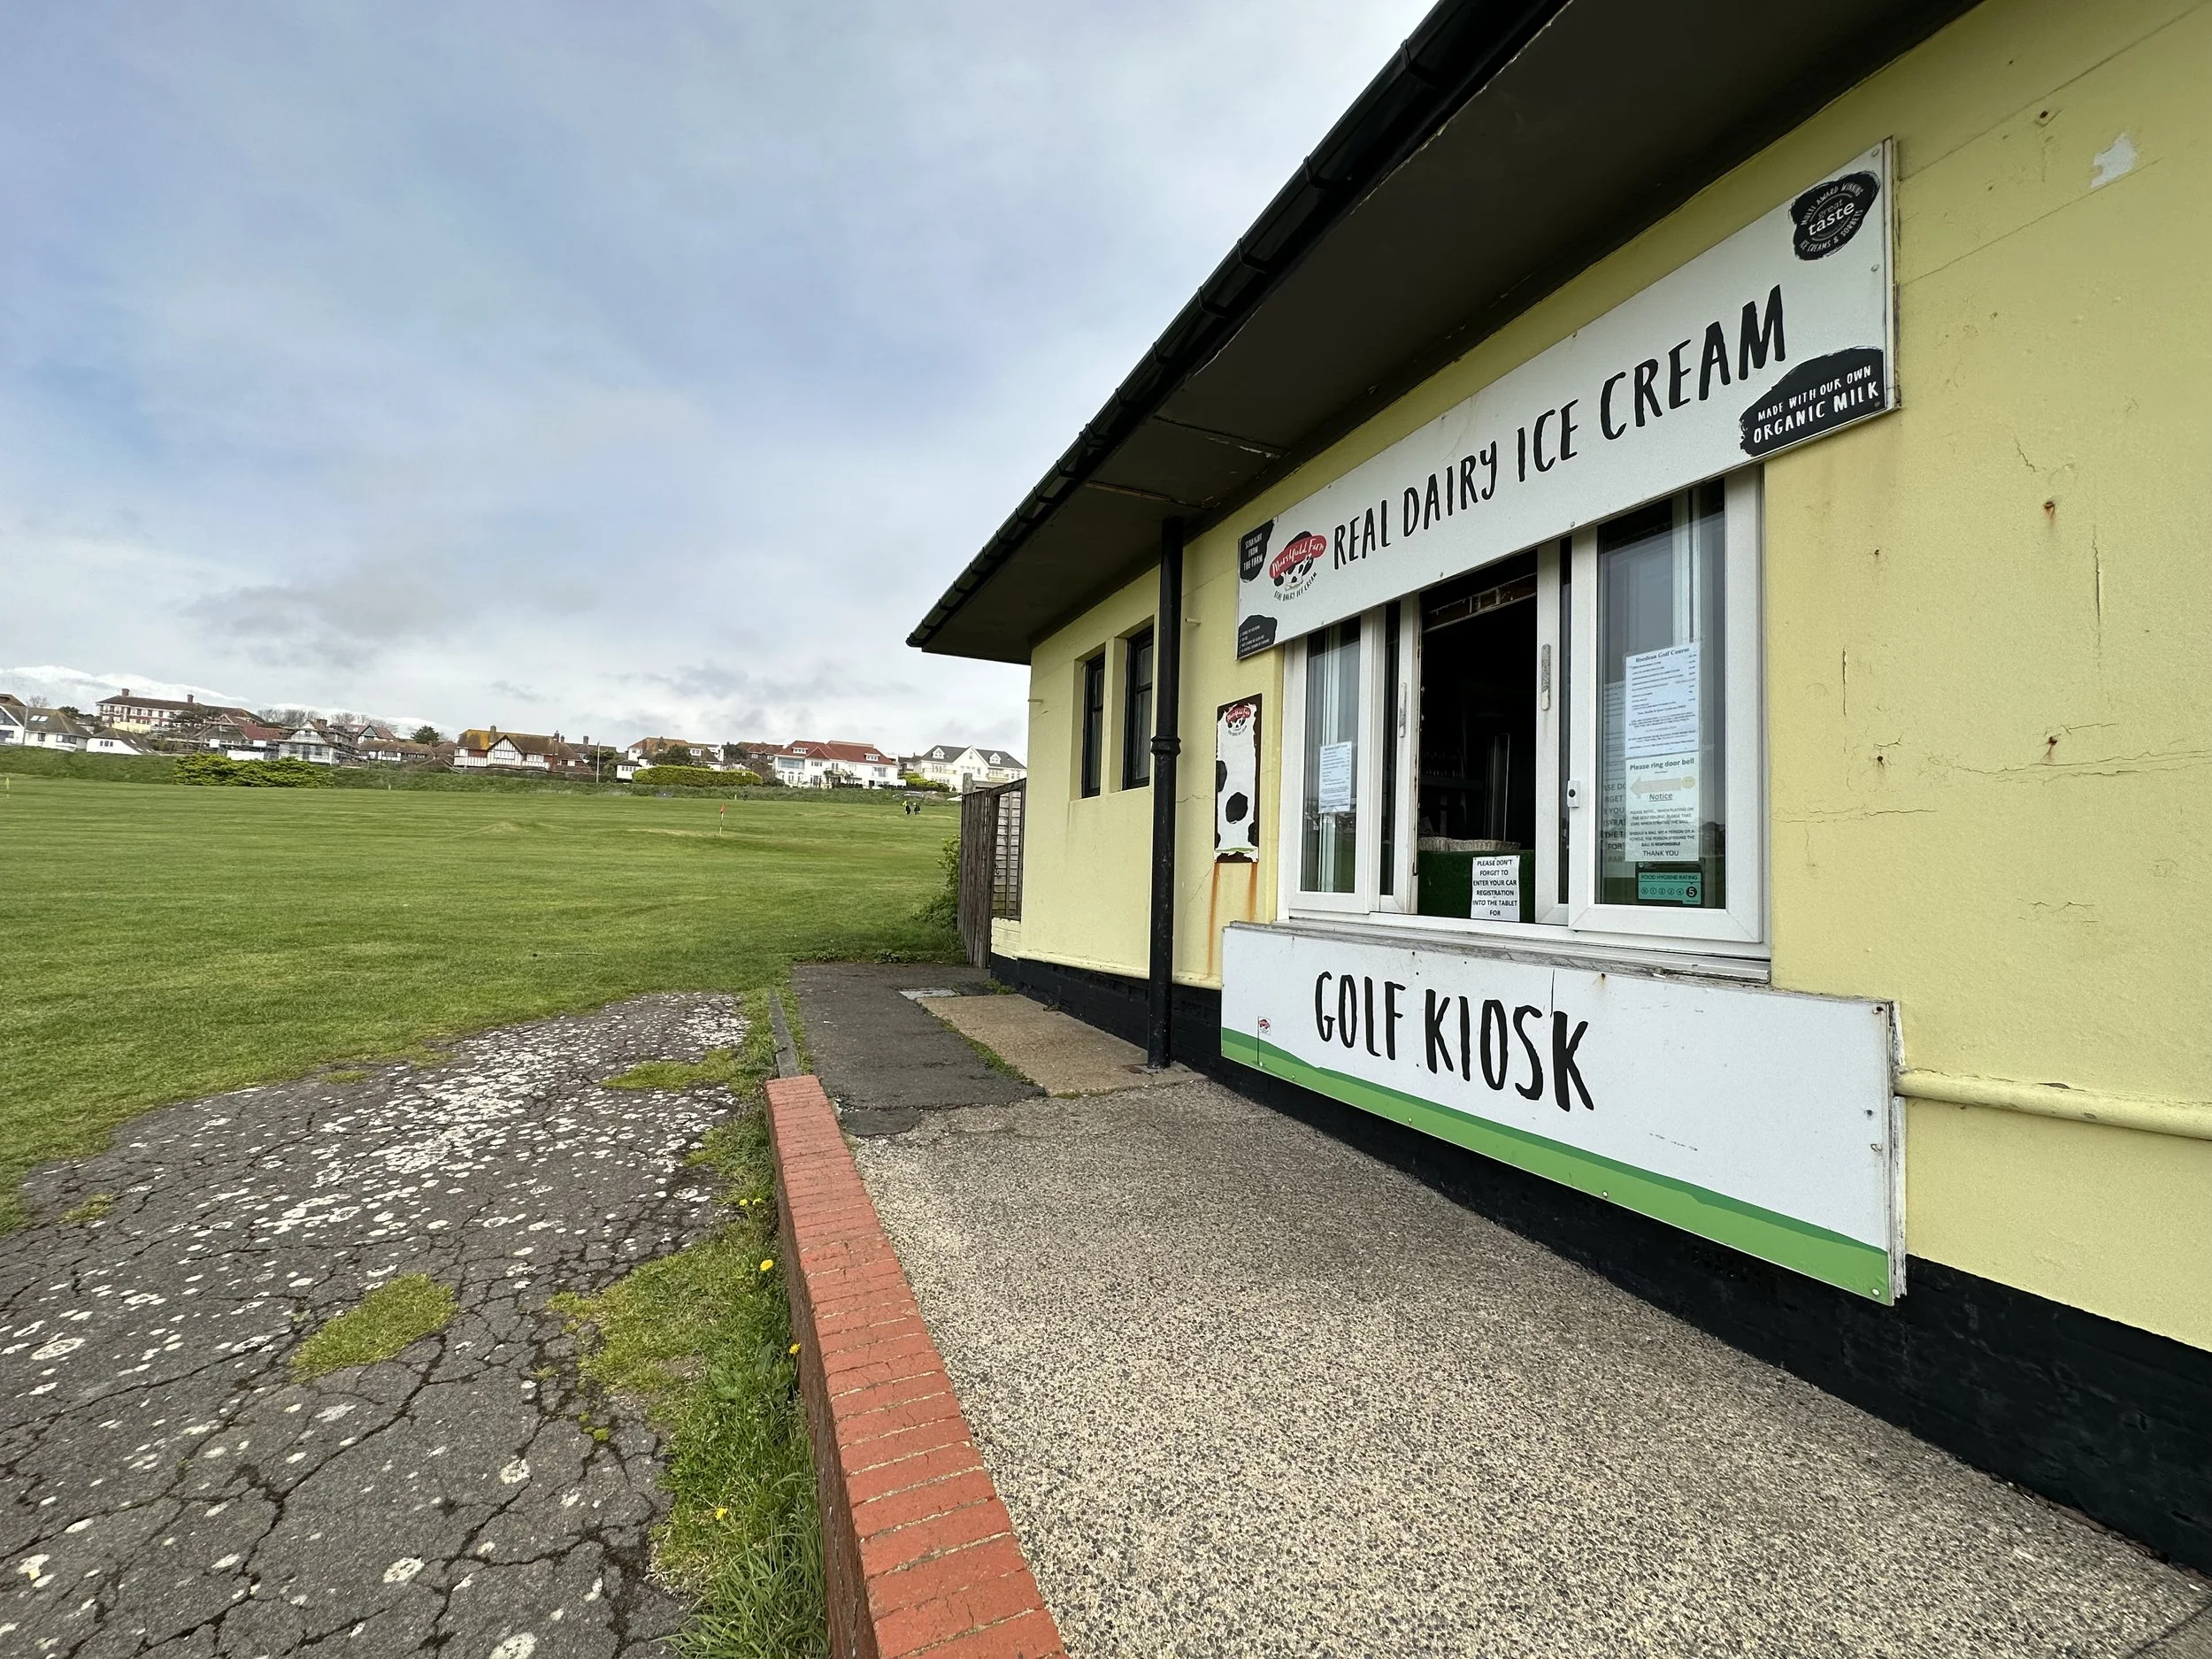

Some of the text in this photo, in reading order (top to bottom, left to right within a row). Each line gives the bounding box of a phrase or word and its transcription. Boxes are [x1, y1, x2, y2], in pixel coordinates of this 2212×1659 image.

[1801, 182, 1863, 226] MULTI AWARD WINNING
[1809, 203, 1855, 235] taste
[1818, 199, 1843, 220] great
[1807, 240, 1832, 252] CREAMS
[1840, 209, 1863, 237] SORBETS
[1753, 381, 1878, 443] ORGANIC MILK
[1757, 365, 1871, 422] MADE WITH OUR OWN
[1333, 284, 1786, 571] REAL DAIRY ICE CREAM
[1251, 553, 1263, 567] FARM
[1309, 539, 1325, 554] Farm
[1314, 971, 1594, 1112] GOLF KIOSK
